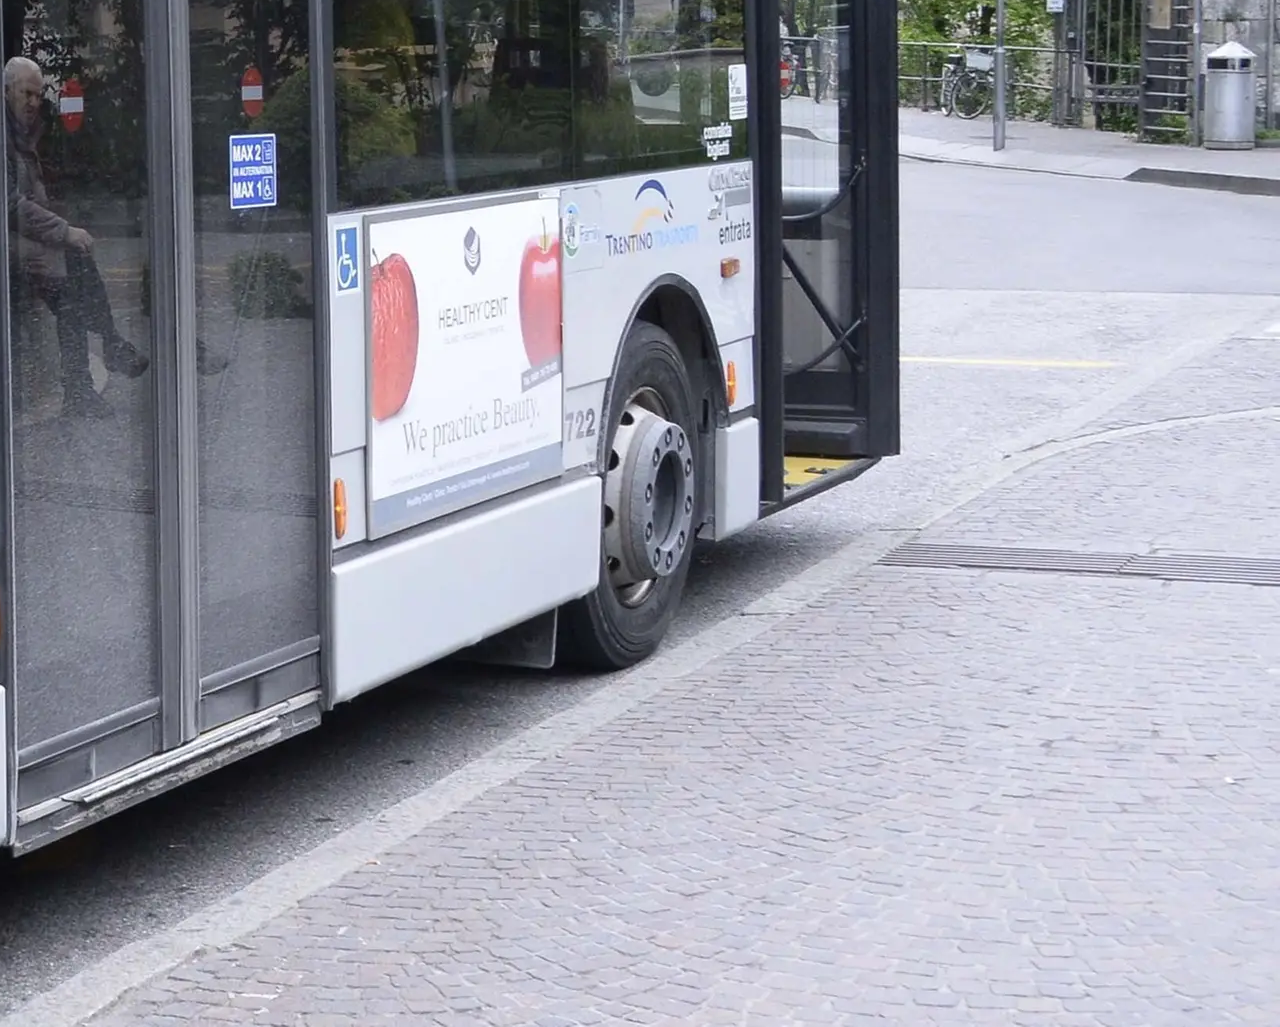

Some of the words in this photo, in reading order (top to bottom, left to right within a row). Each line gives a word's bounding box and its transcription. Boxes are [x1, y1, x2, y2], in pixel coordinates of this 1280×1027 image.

[232, 144, 254, 162] MAX
[254, 143, 262, 162] 2
[233, 181, 254, 199] MAX
[256, 180, 262, 197] 1
[719, 218, 751, 245] entrata
[438, 302, 483, 330] HEALTHY
[402, 420, 428, 455] We
[432, 405, 489, 458] practice
